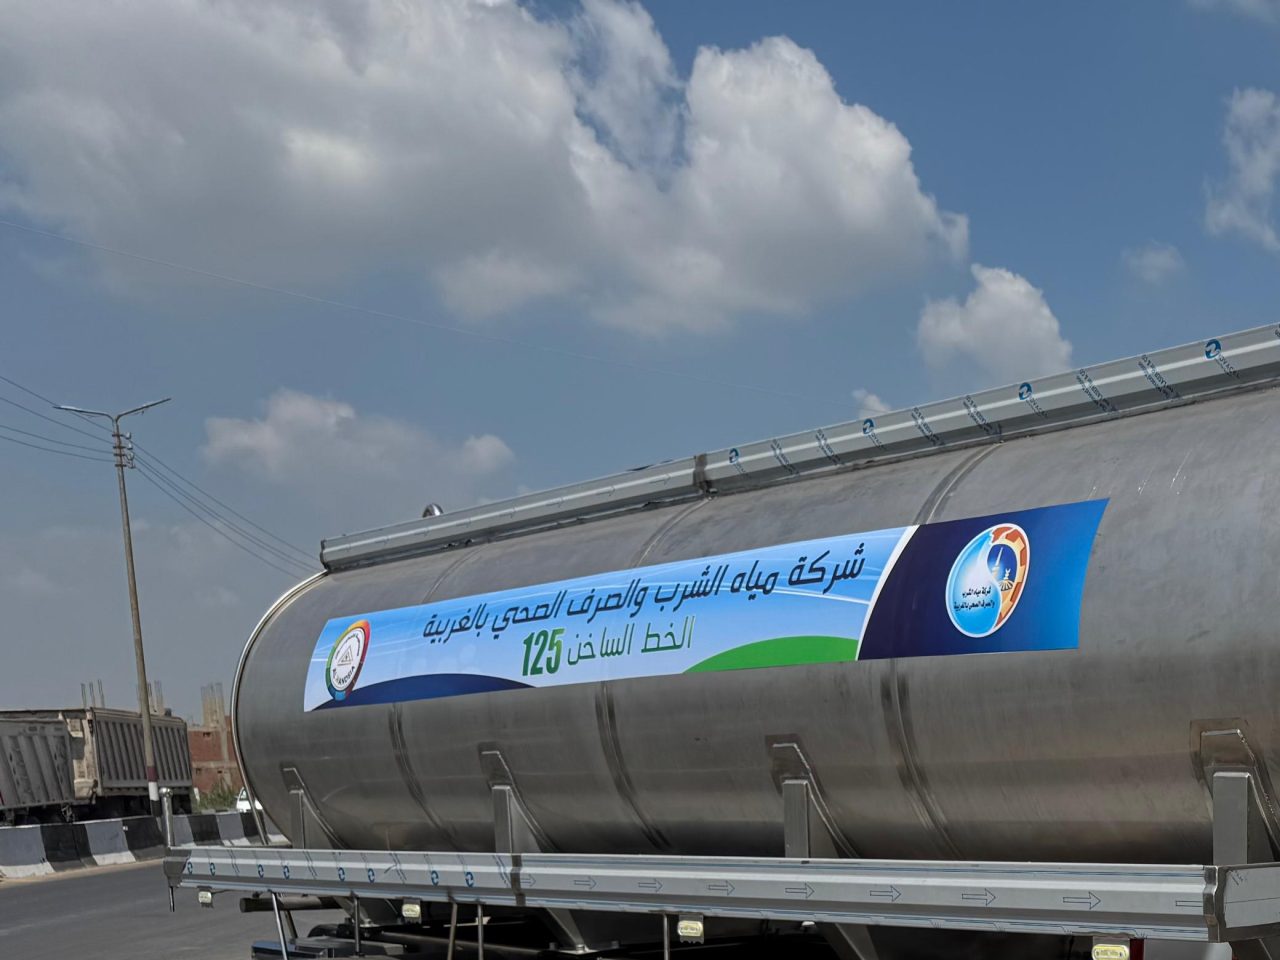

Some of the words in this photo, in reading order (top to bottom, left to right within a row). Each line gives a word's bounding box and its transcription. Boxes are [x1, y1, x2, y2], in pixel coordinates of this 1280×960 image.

[654, 564, 730, 612] الشرب
[730, 559, 780, 601] مياه
[788, 542, 866, 594] شركة
[422, 602, 490, 644] بالغربية
[491, 589, 567, 641] الصحي
[566, 577, 649, 624] والصرف
[522, 628, 565, 676] 125
[567, 622, 636, 666] الساخن
[641, 615, 696, 654] الخط
